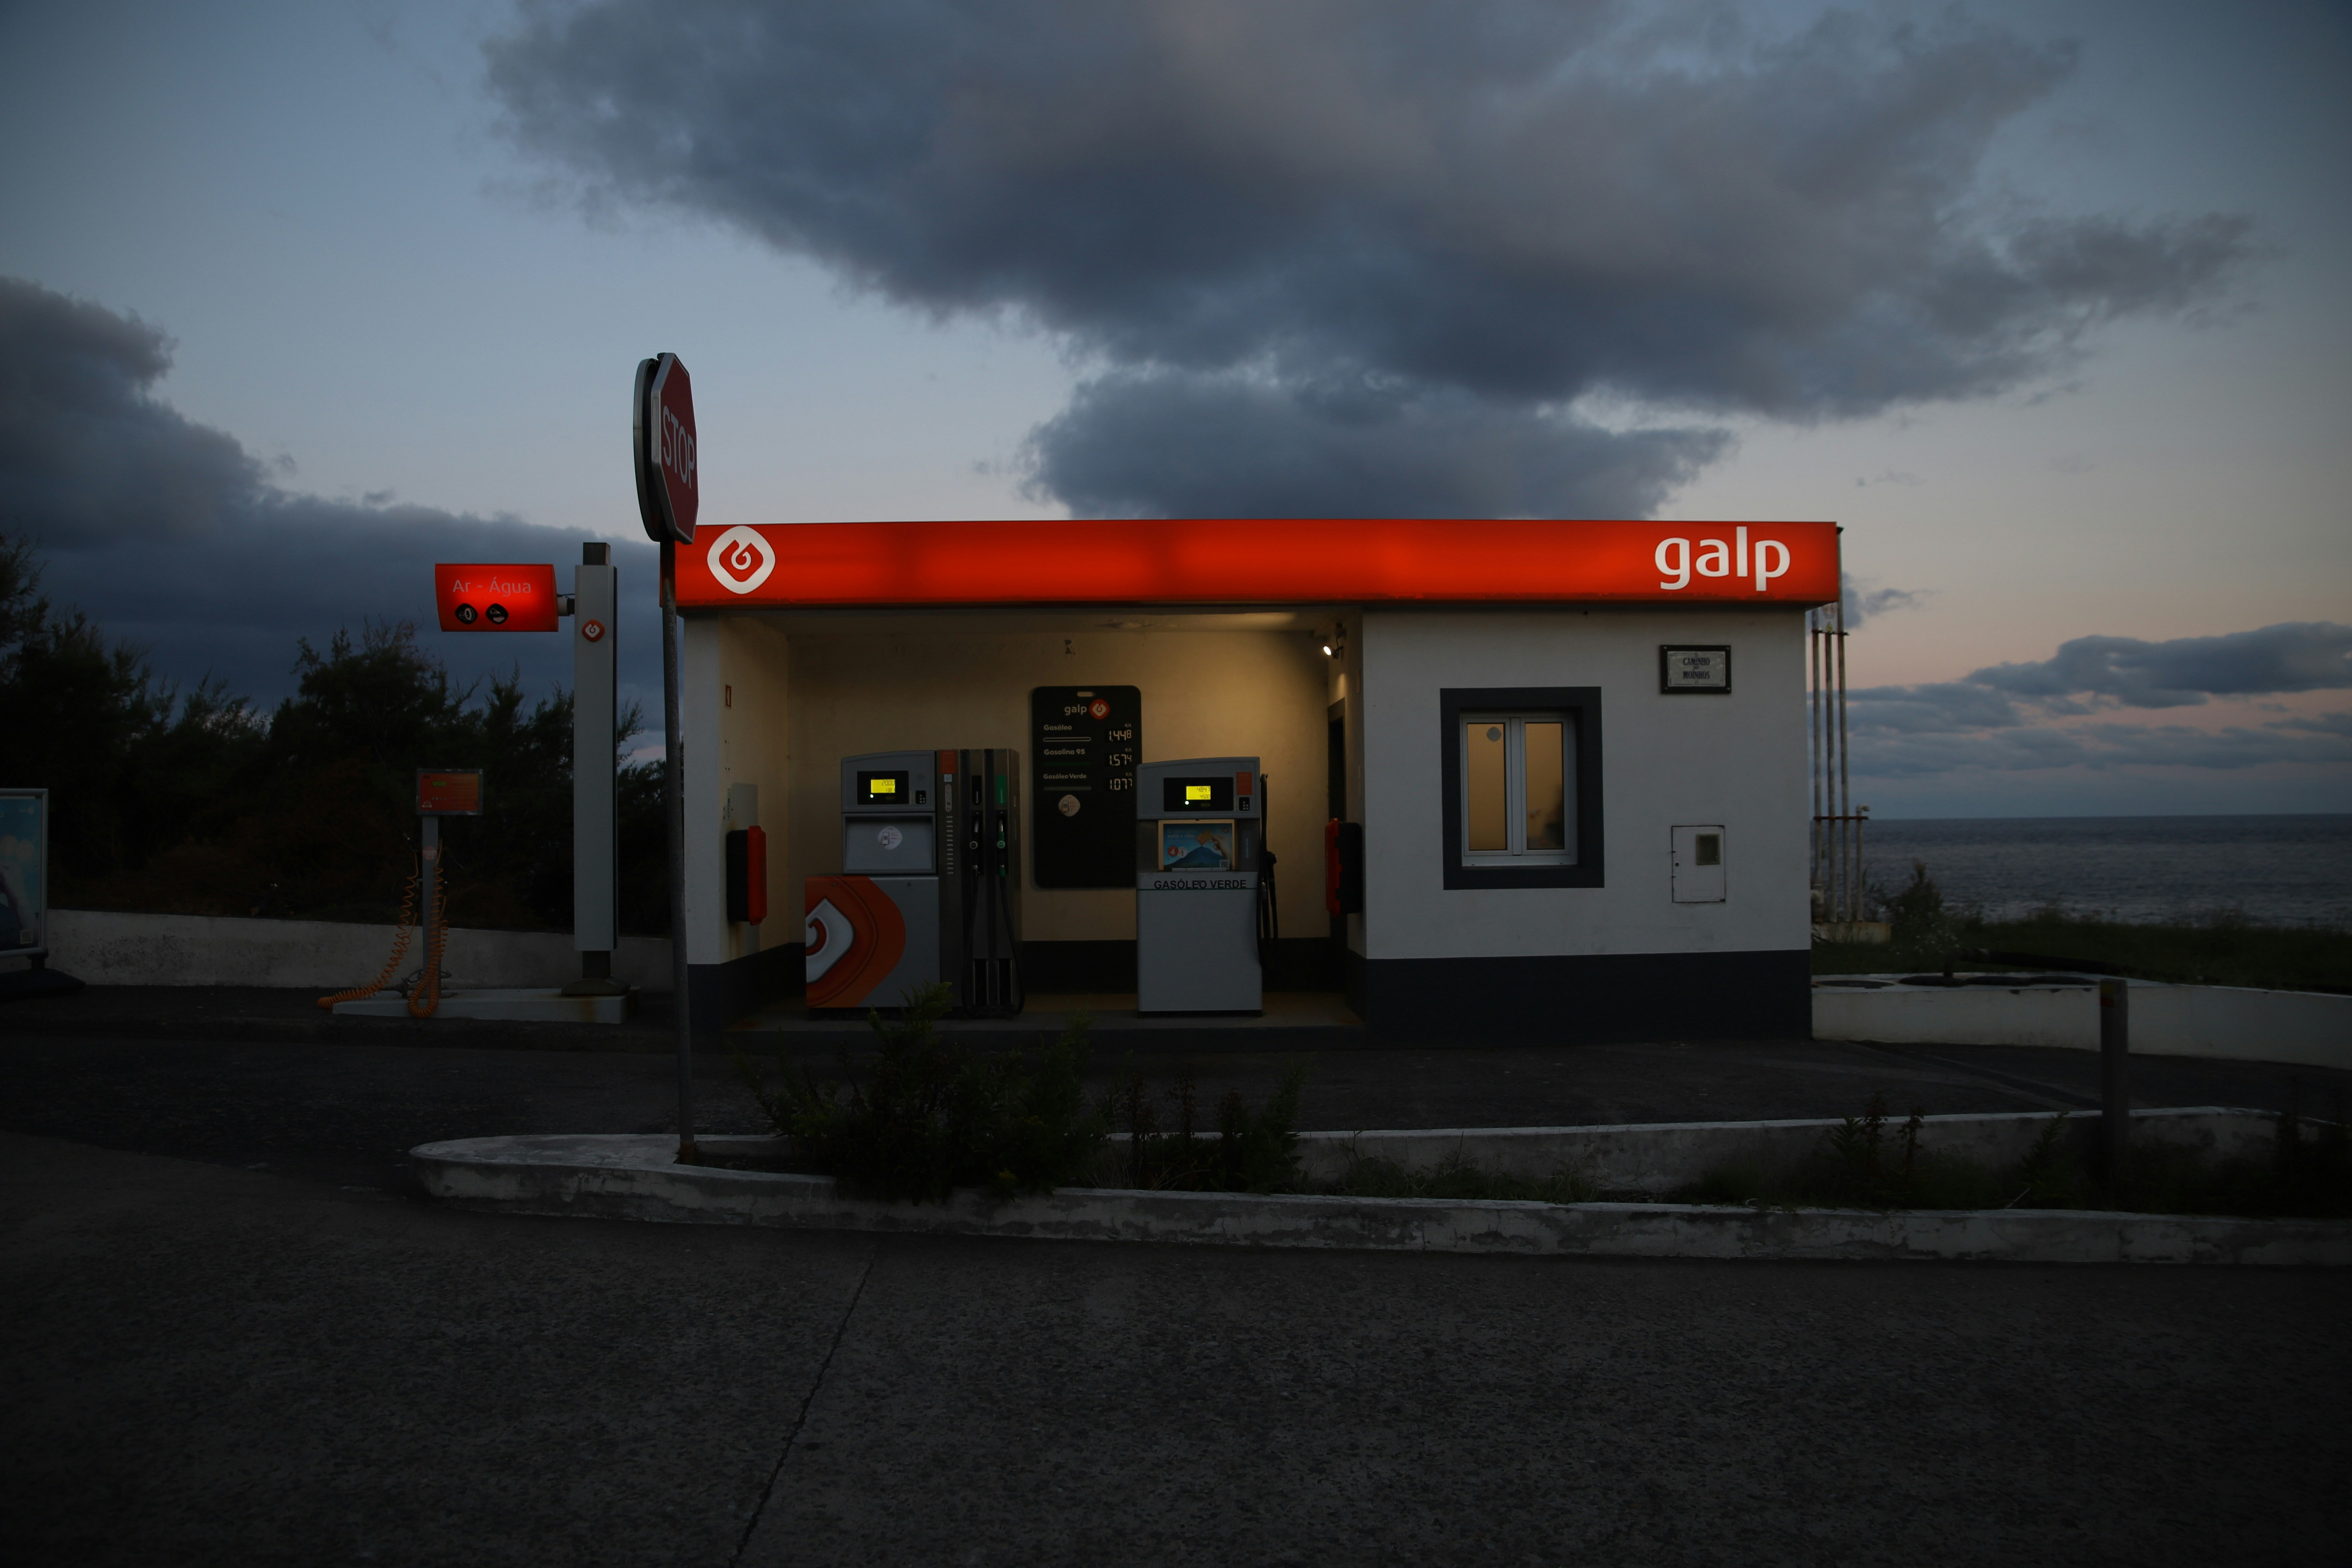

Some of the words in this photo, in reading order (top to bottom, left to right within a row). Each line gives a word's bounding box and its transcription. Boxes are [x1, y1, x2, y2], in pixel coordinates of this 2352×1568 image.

[663, 405, 695, 489] STOP
[1654, 526, 1791, 591] galp
[452, 579, 471, 593] Ar
[488, 576, 531, 597] Água
[1683, 657, 1710, 666] CAMINHO
[1064, 704, 1087, 715] galp
[1109, 729, 1132, 741] 1.448
[1109, 754, 1132, 766] 1.574
[1154, 878, 1207, 889] GASÓLEO
[1210, 879, 1246, 888] VERDE
